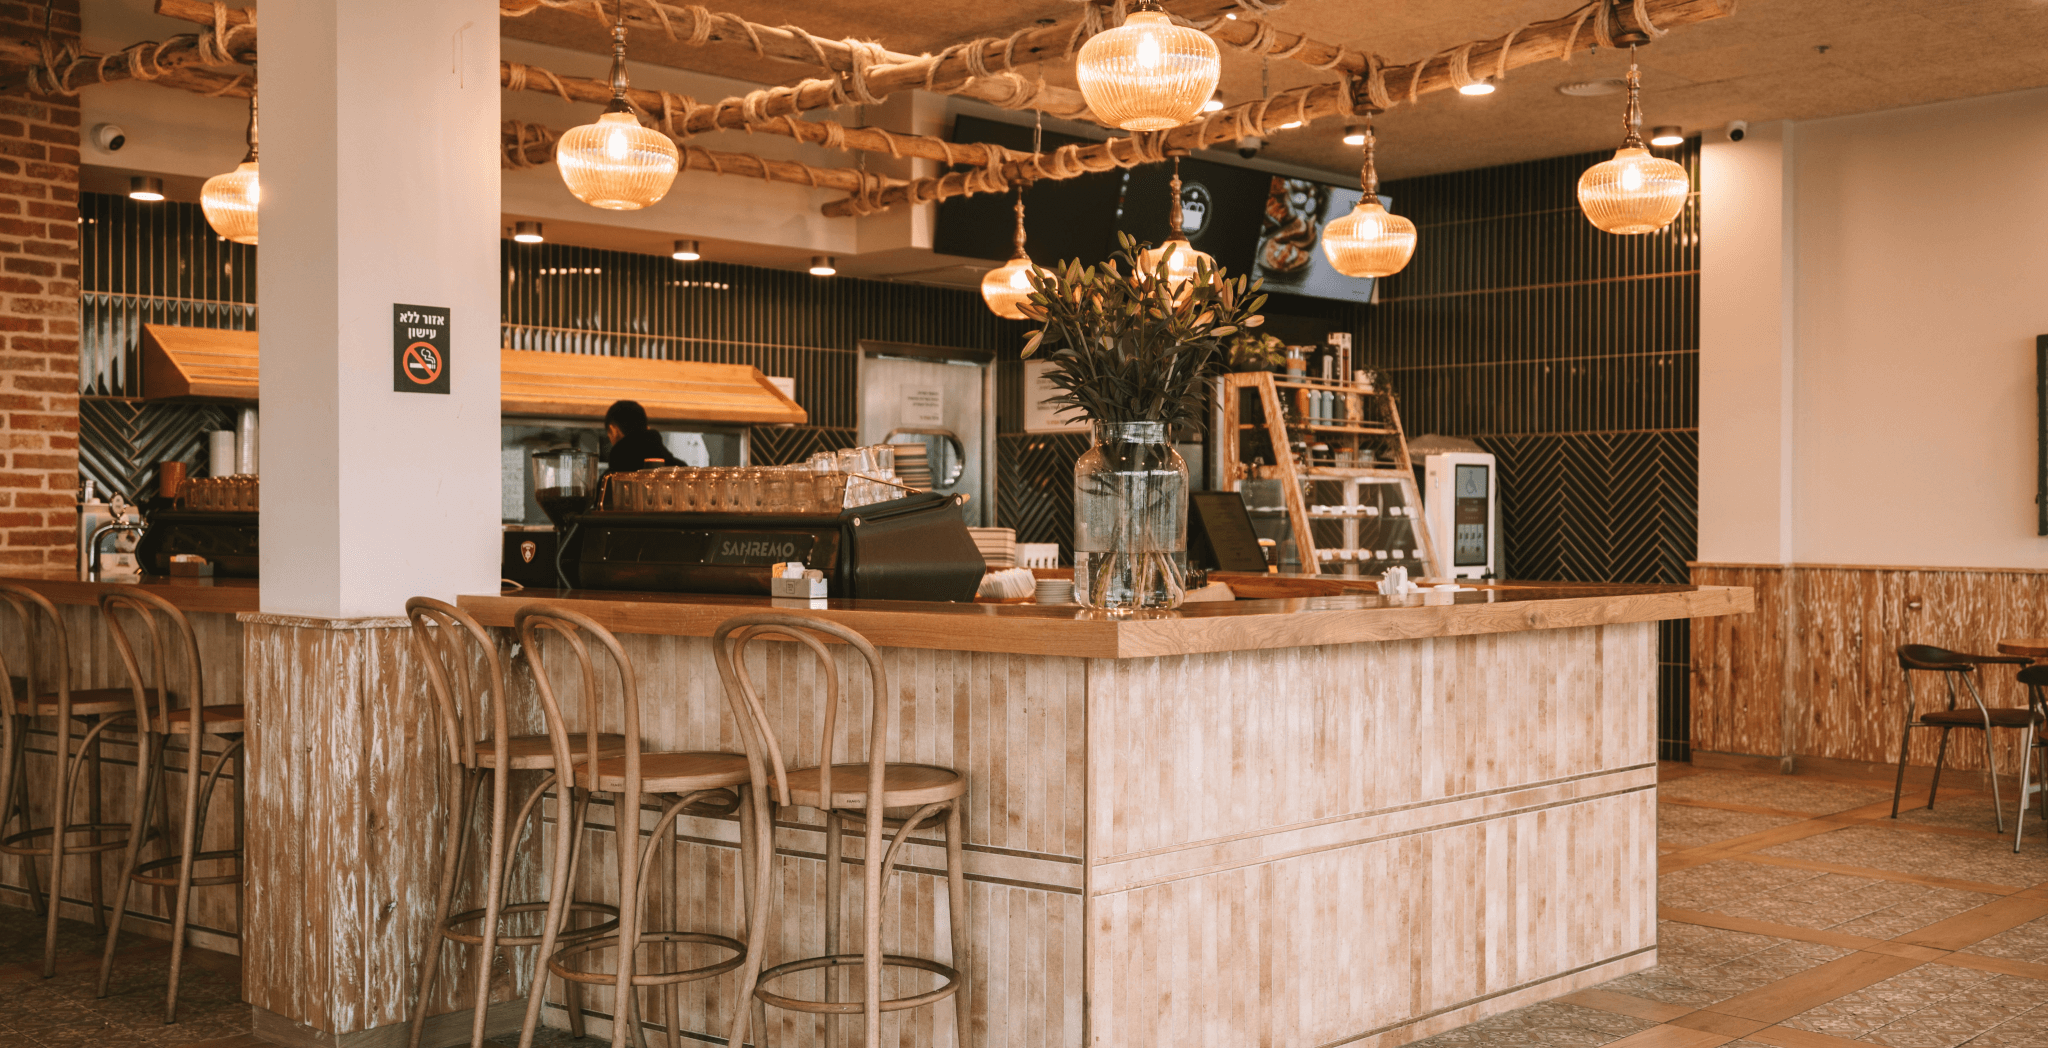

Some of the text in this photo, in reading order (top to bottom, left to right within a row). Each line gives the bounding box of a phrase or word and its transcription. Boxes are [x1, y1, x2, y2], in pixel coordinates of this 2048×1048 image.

[400, 311, 444, 326] אזור ללא
[408, 327, 436, 339] עישון
[721, 541, 795, 557] SANREMO
